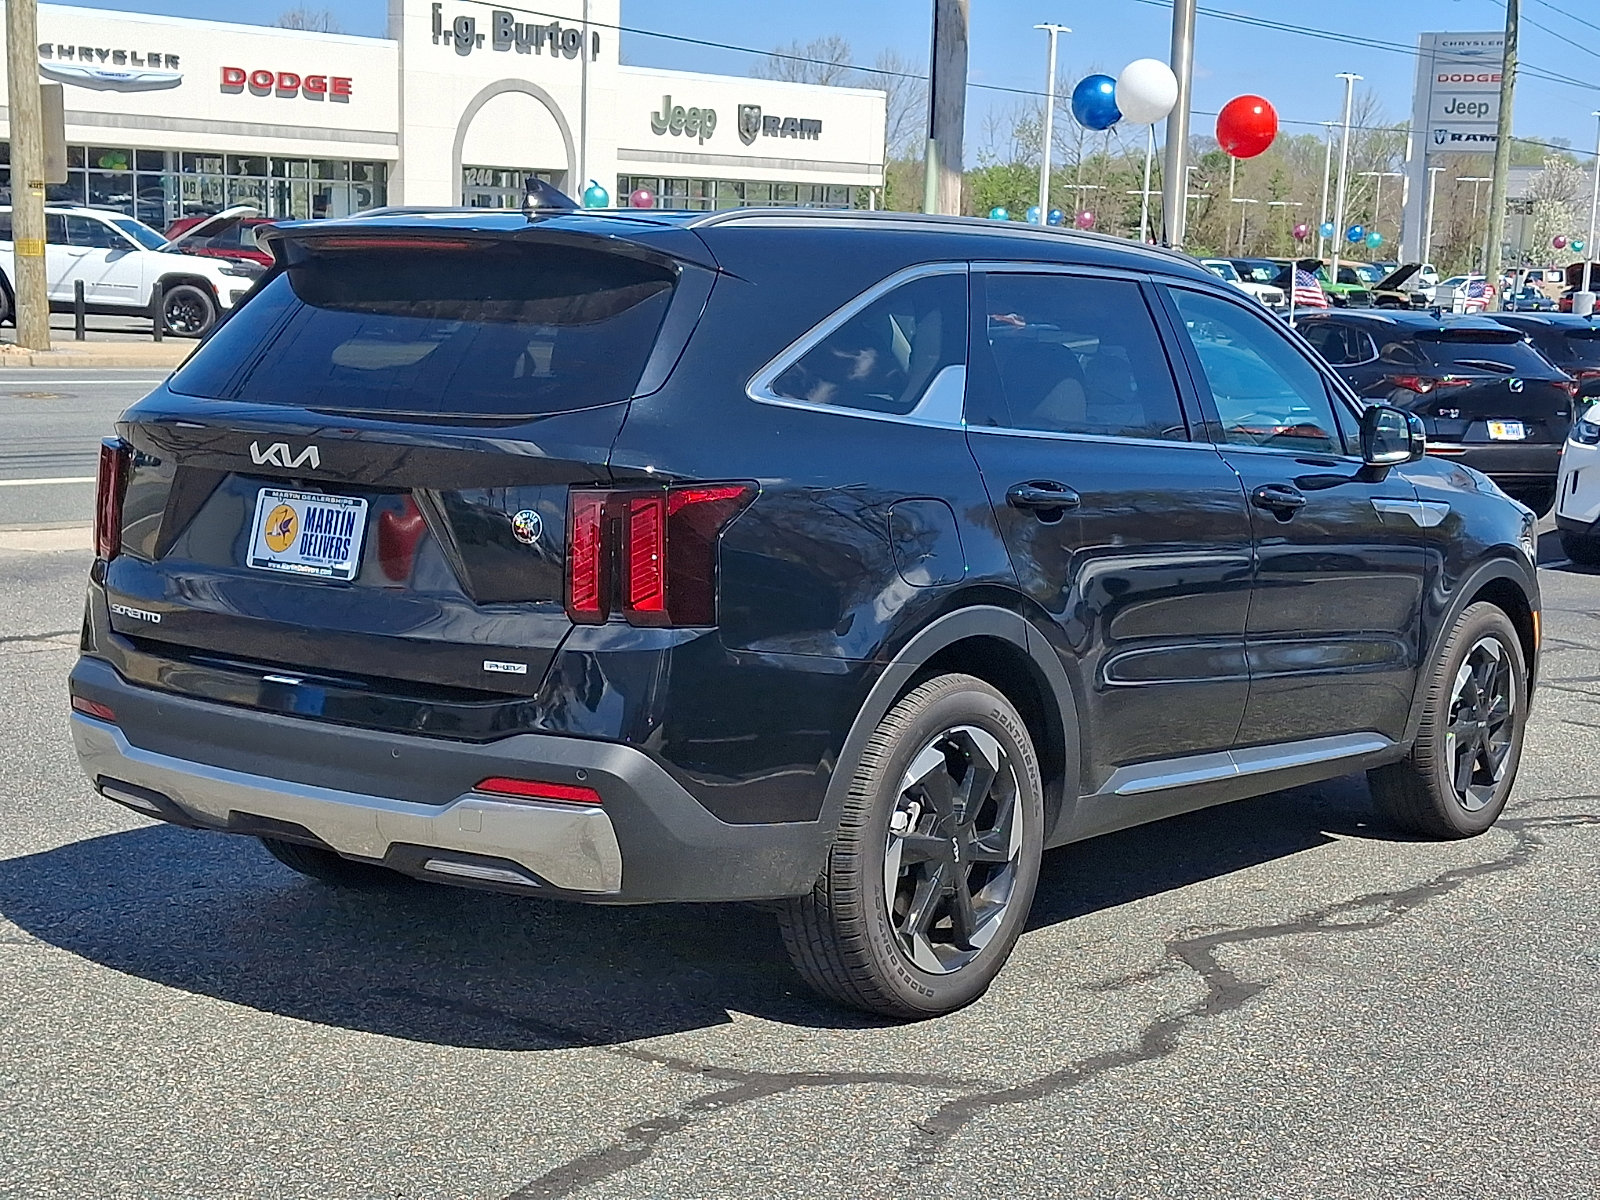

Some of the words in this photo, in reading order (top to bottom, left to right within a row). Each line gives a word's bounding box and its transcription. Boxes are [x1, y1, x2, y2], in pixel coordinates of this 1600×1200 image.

[38, 43, 180, 70] CHRYSLER
[219, 66, 353, 104] DODGE
[1438, 74, 1503, 82] DODGE
[651, 95, 717, 145] Jeep
[1444, 98, 1489, 118] Jeep
[762, 115, 823, 141] RAM
[1450, 133, 1500, 142] RAM
[250, 441, 320, 470] KIA
[272, 492, 300, 500] MARTIN
[303, 506, 357, 538] MARTIN
[299, 534, 351, 560] DELIVERS
[111, 603, 161, 624] SORENTO
